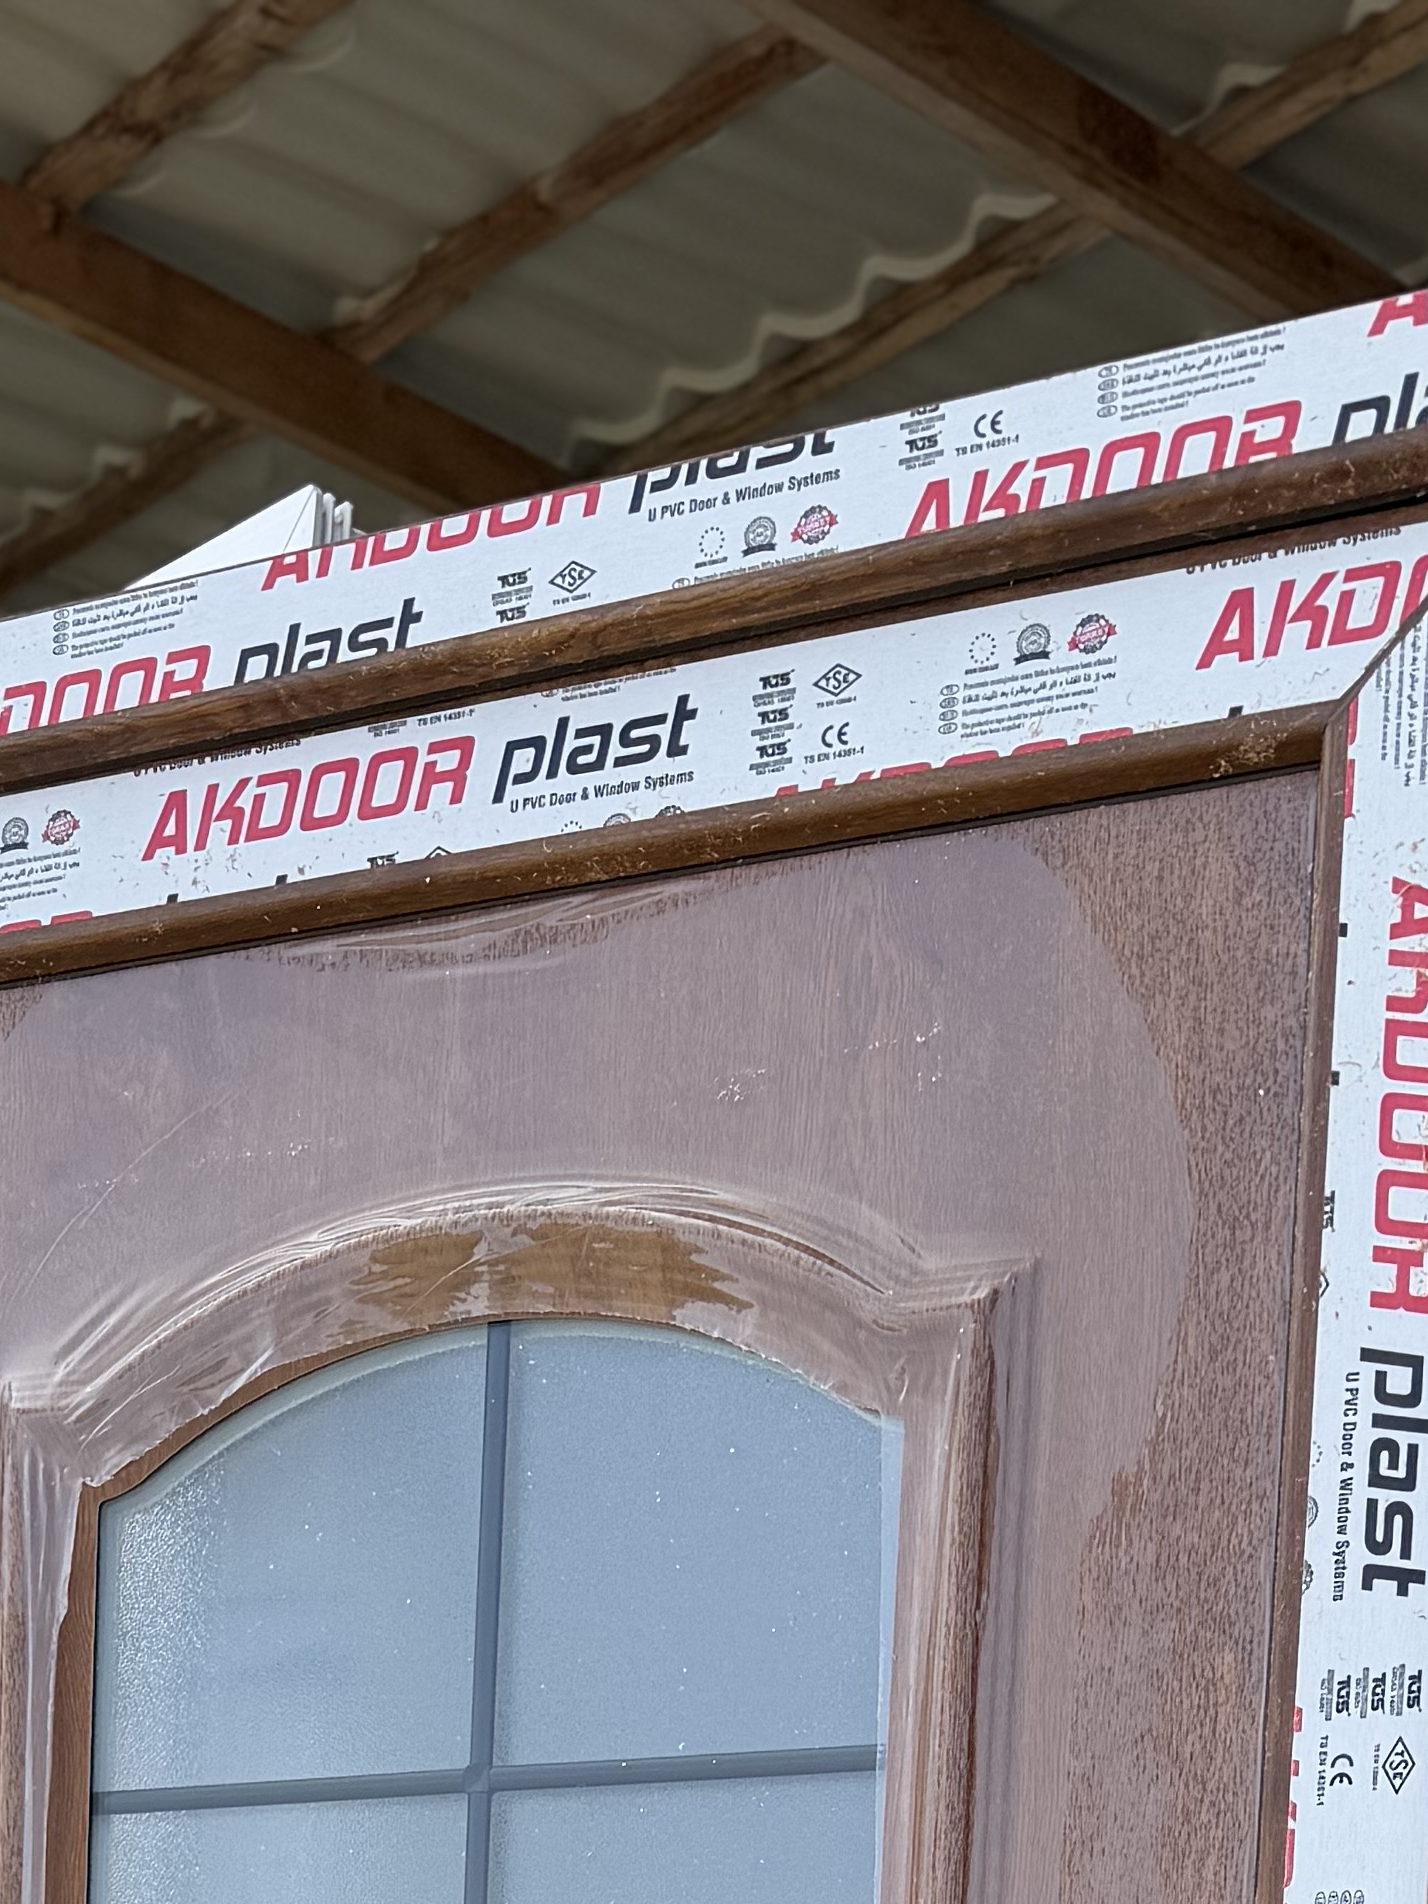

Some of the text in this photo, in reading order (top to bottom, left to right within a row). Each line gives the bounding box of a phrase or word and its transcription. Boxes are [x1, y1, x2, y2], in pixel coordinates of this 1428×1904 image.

[647, 468, 840, 522] U PVC Door & Window Systems
[231, 597, 424, 688] plast
[141, 693, 698, 862] AKDOOR plast
[509, 770, 694, 813] U PVC Door & Window Systems
[1331, 1371, 1360, 1602] U PVC Door & Window Systems
